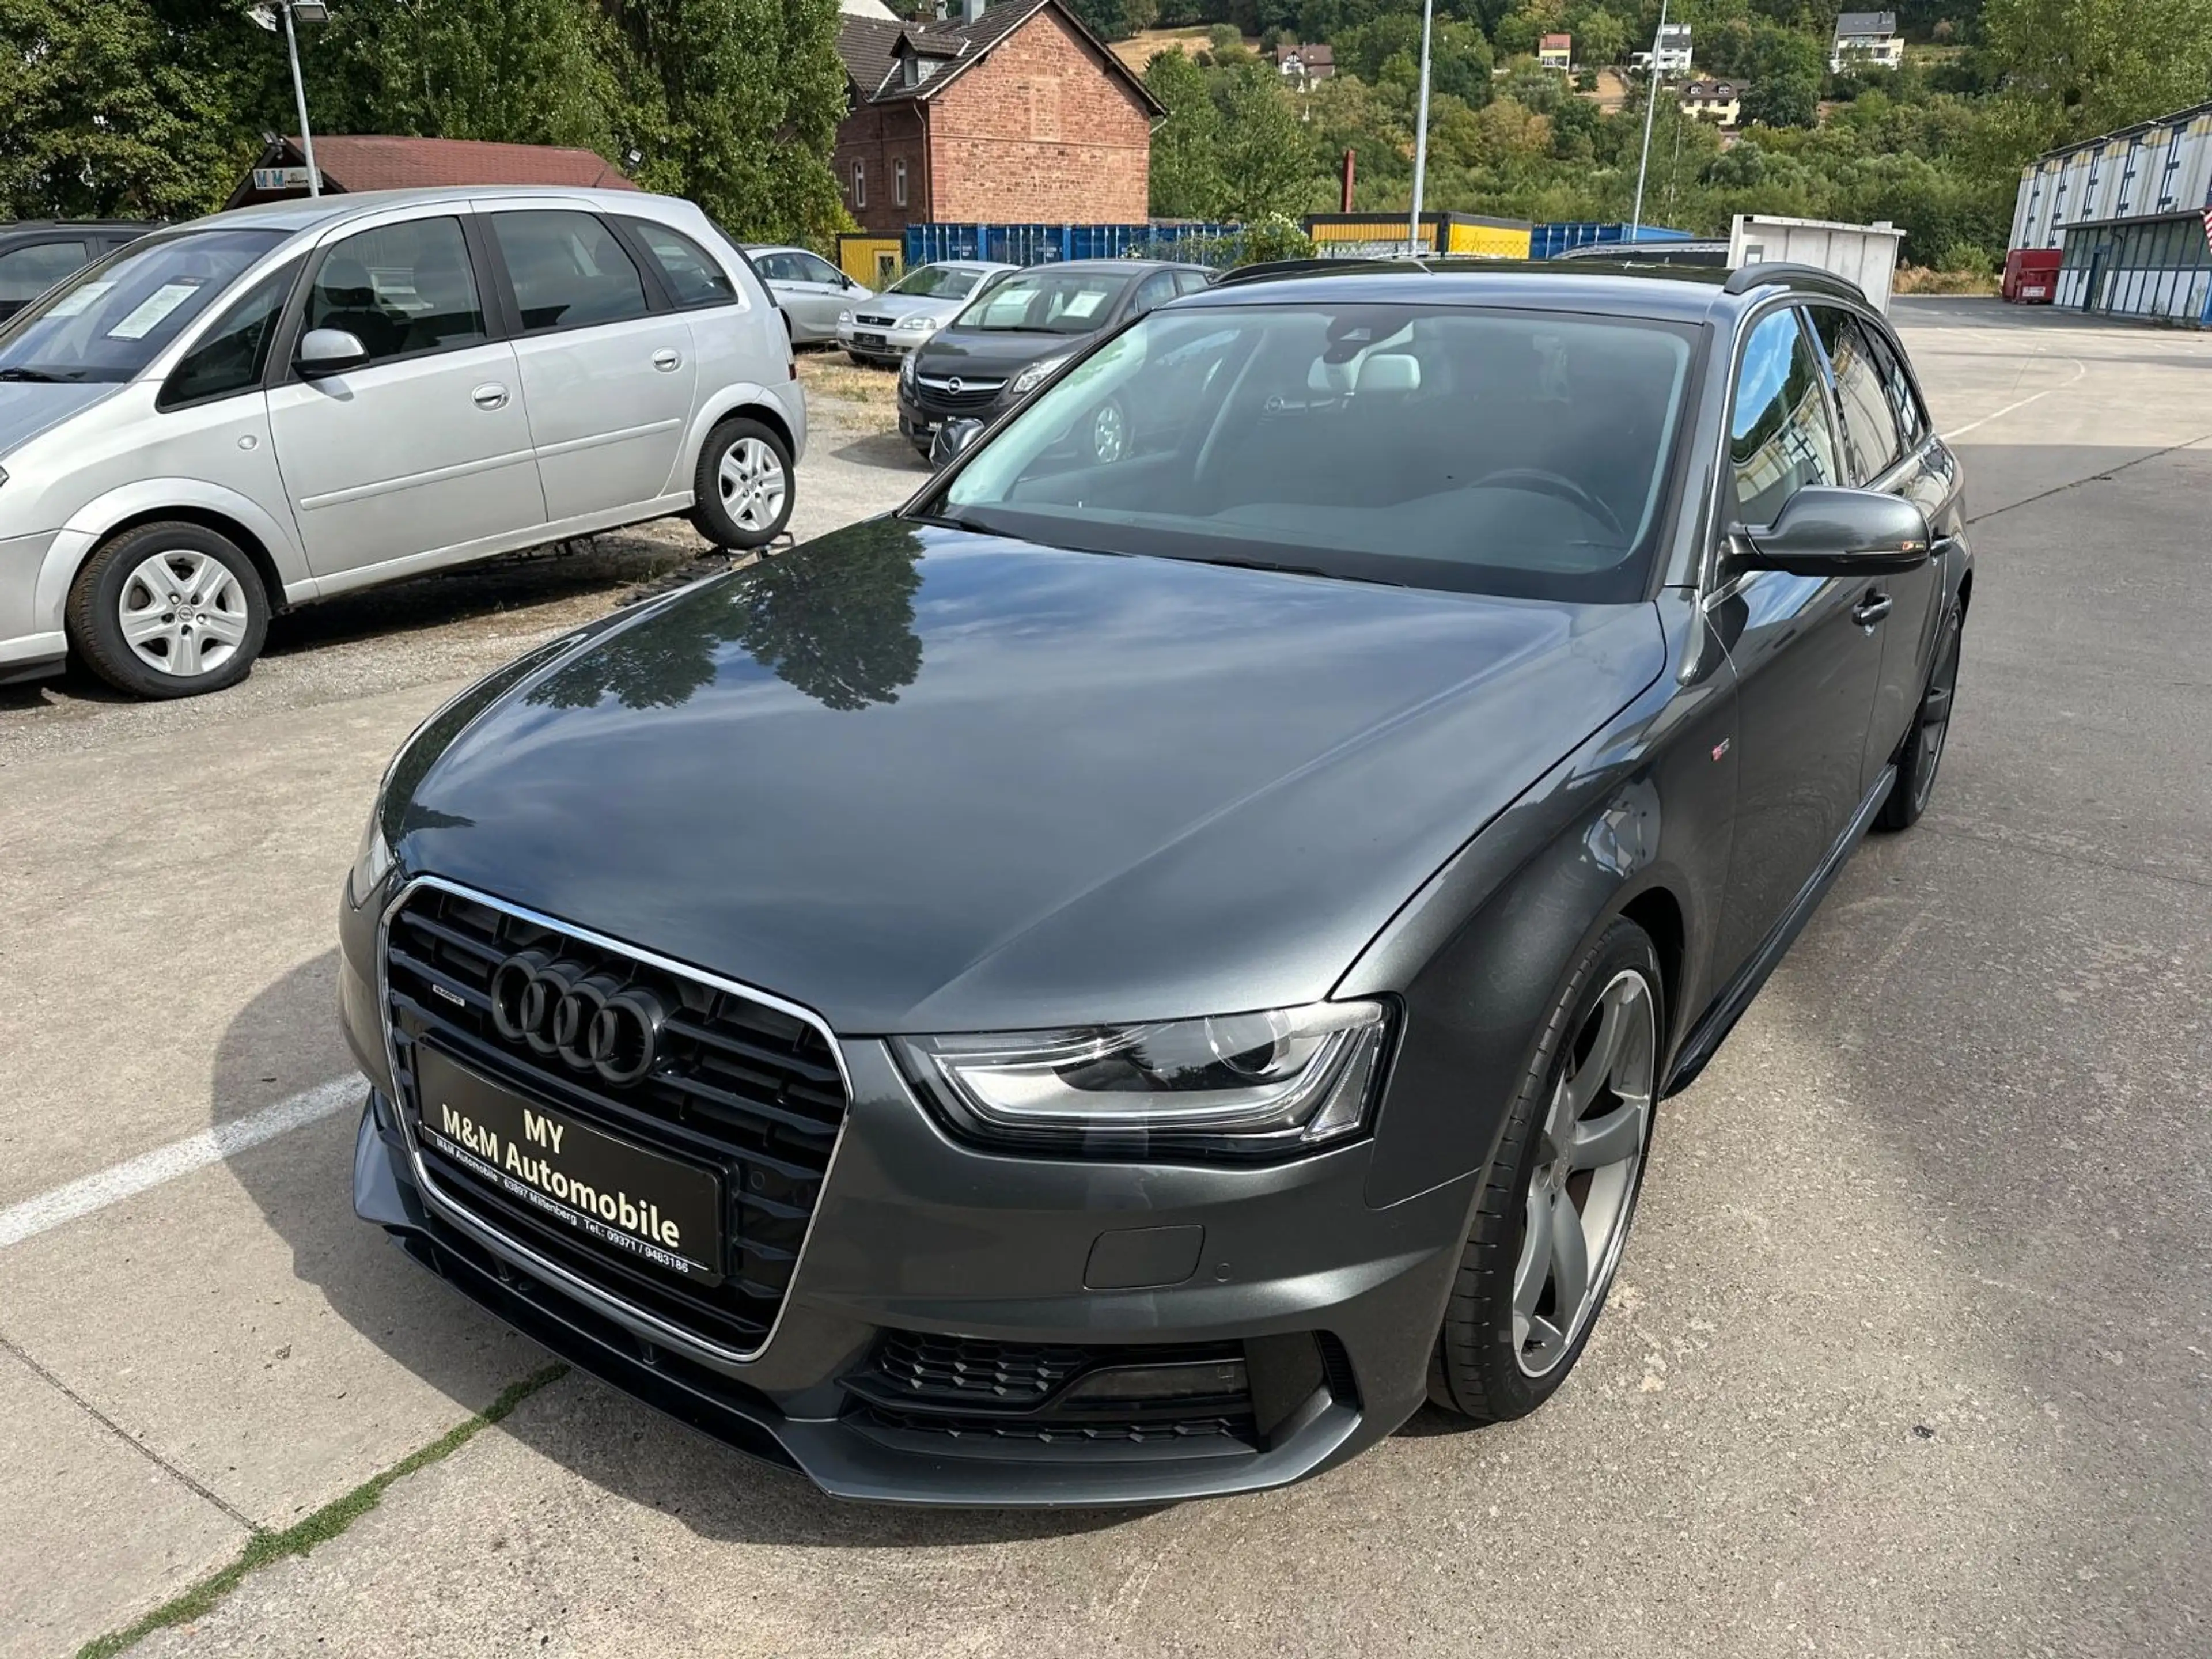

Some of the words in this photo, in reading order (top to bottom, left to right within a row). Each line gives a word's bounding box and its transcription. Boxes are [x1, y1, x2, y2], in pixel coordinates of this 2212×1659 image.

[524, 1108, 564, 1154] MY
[442, 1103, 499, 1164] M&M
[505, 1142, 680, 1248] Automobile
[607, 1230, 636, 1251] 09371
